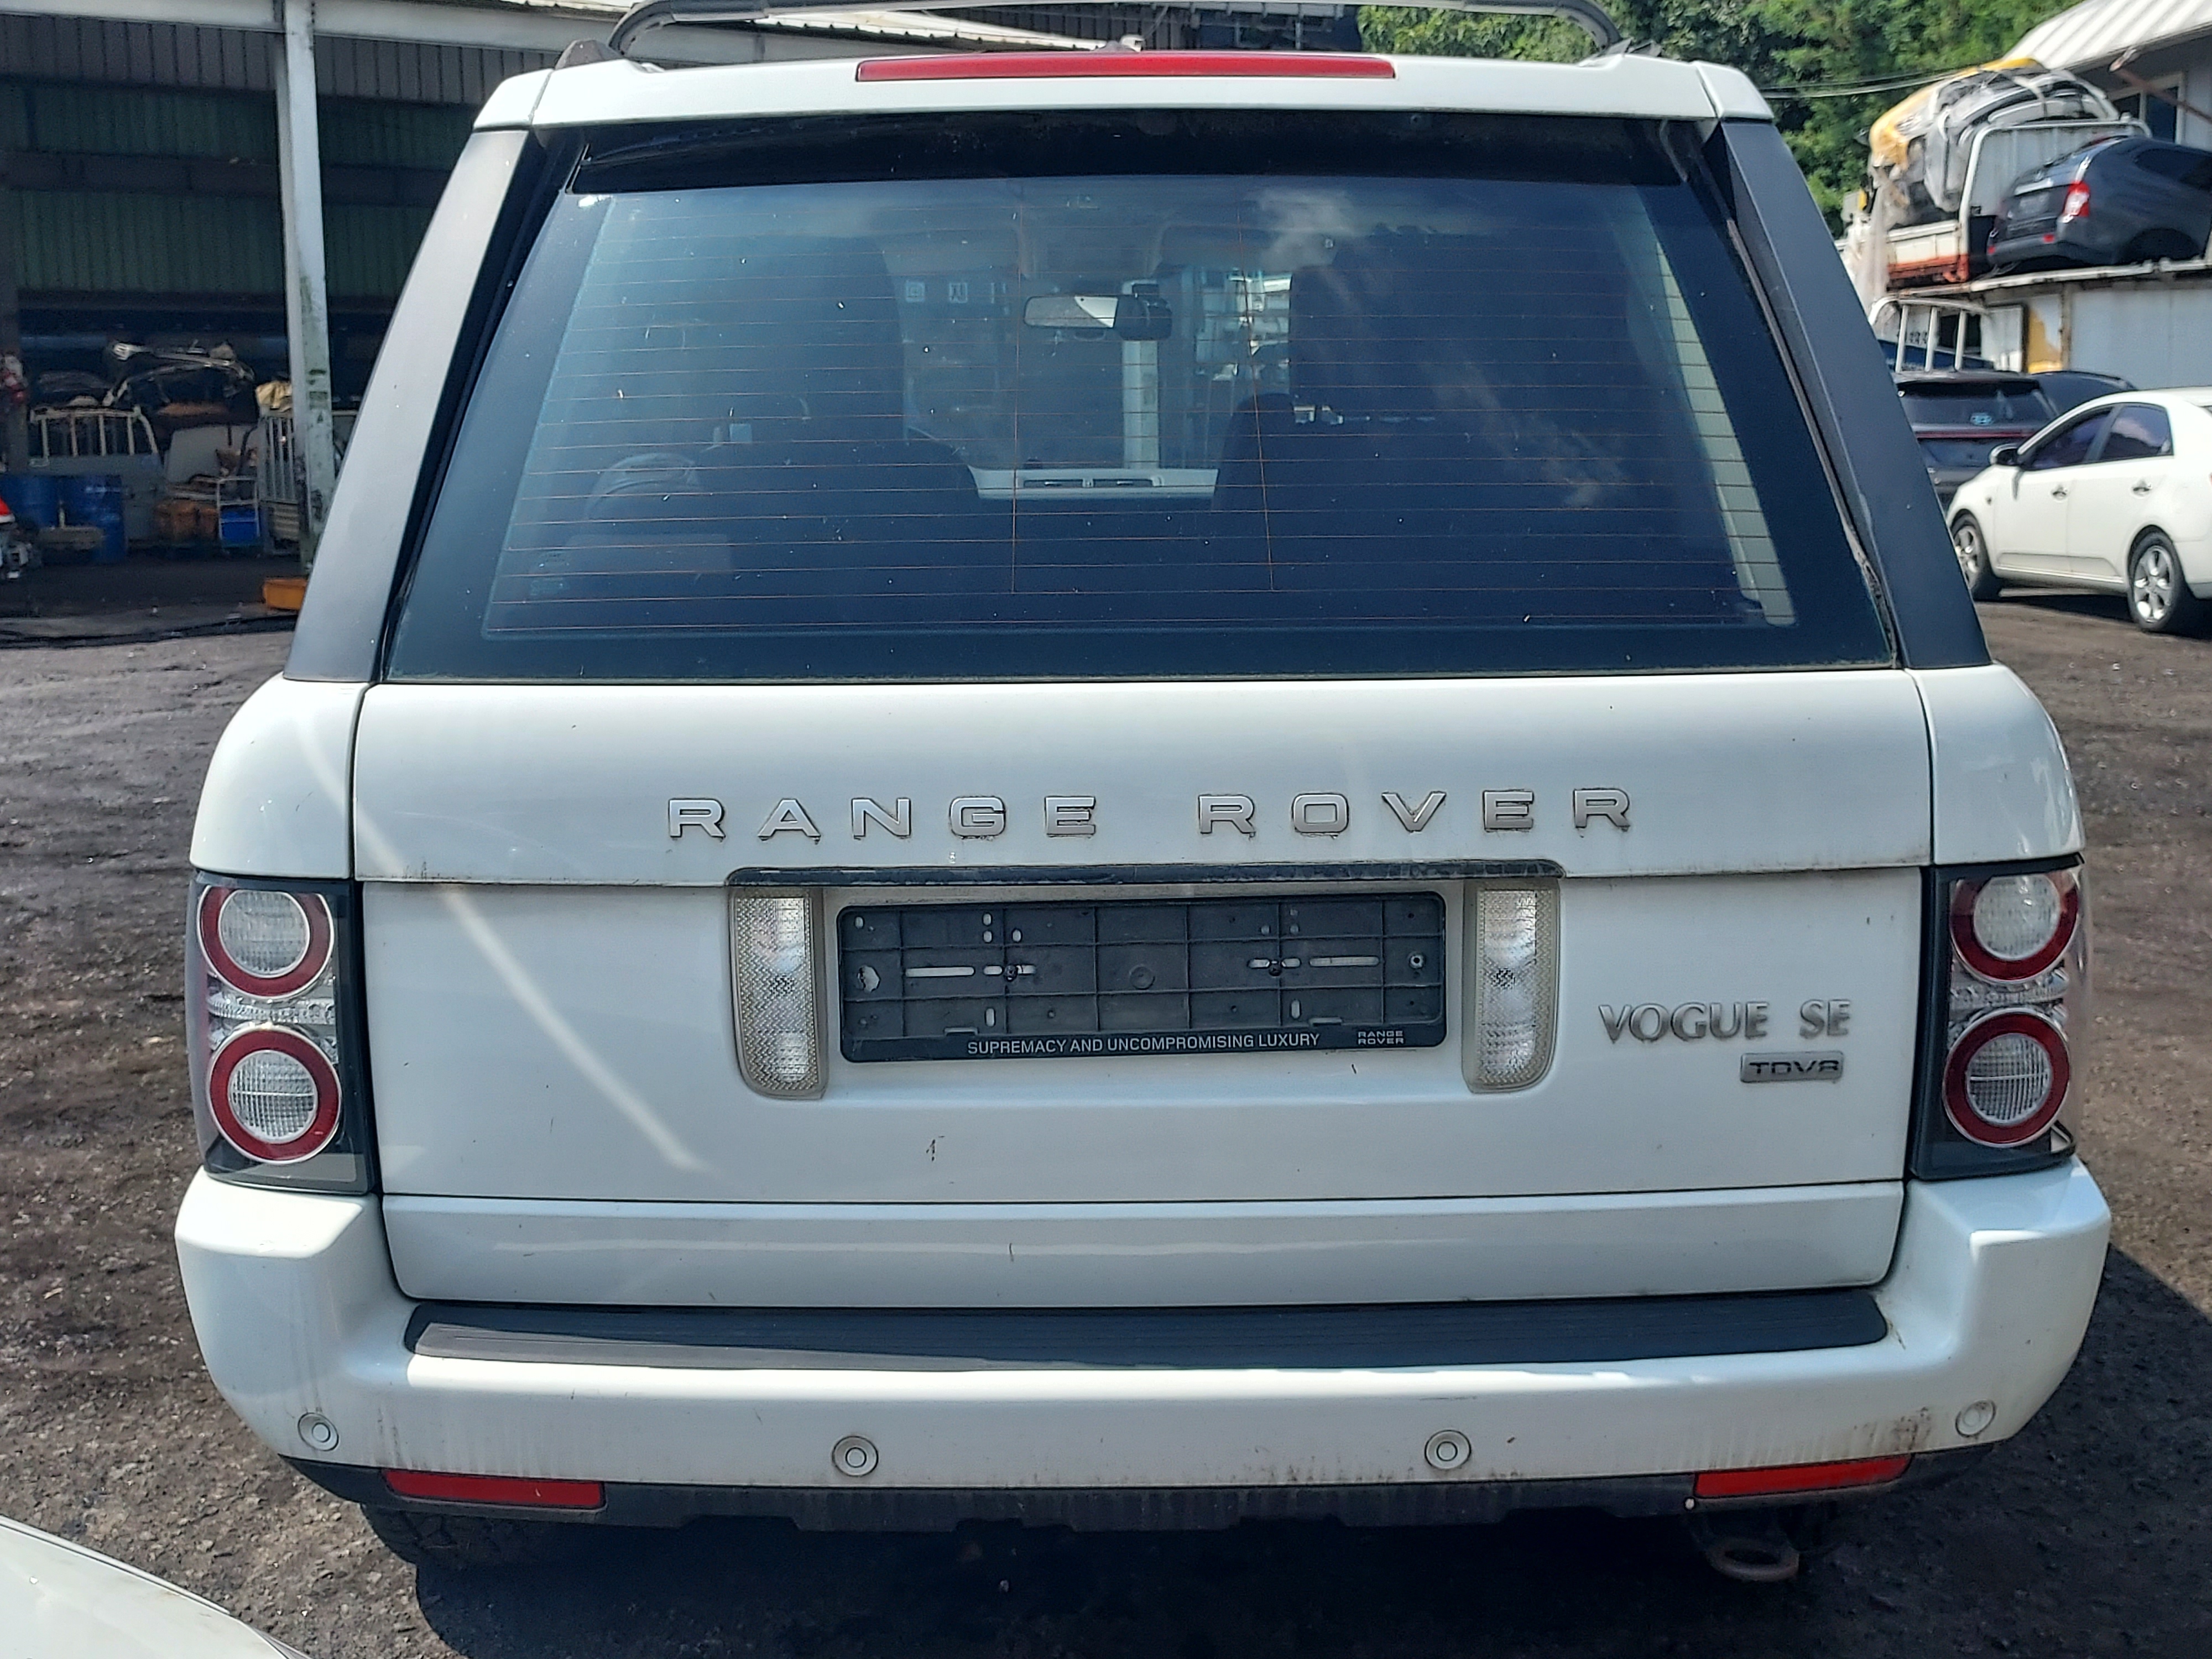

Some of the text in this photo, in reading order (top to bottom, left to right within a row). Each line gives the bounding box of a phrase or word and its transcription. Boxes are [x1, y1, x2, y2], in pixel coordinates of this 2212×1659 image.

[668, 789, 1632, 839] RANGE ROVER
[1598, 999, 1851, 1043] VOGUE SE
[968, 1034, 1320, 1054] SUPREMACY AND UNCOMPROMISING LUXURY
[1749, 1060, 1839, 1074] TDV8
